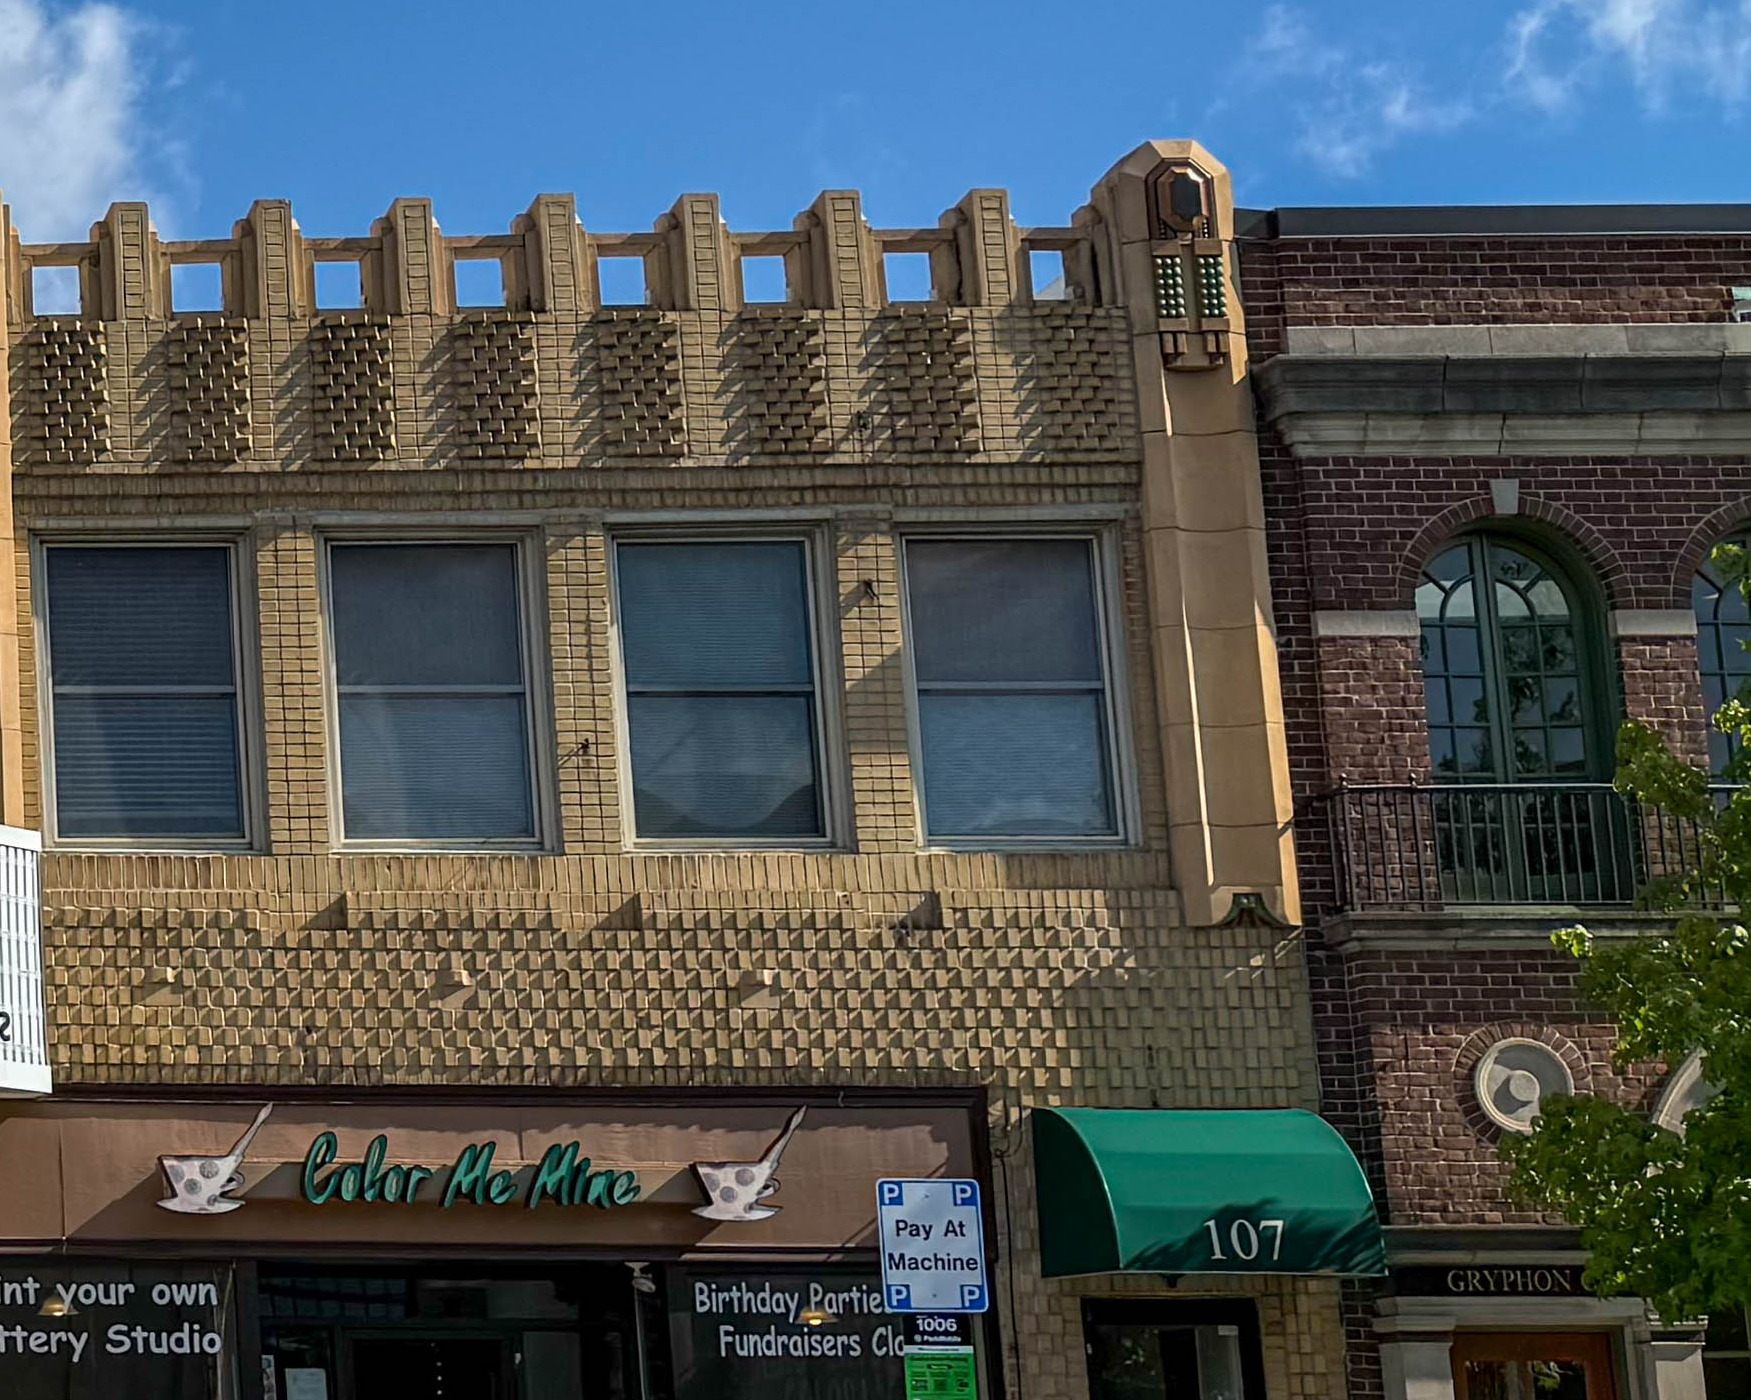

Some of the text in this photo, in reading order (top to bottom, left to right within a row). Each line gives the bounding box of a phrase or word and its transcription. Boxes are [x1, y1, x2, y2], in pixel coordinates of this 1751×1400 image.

[302, 1131, 641, 1209] Color Me Mine
[895, 1219, 966, 1241] Pay At
[1202, 1219, 1284, 1261] 107
[887, 1252, 979, 1272] Machine
[1447, 1269, 1571, 1292] GRYPHON
[55, 1282, 136, 1316] your
[151, 1282, 219, 1306] own
[694, 1281, 892, 1324] Birthday Partie
[104, 1322, 223, 1355] Studio
[718, 1324, 862, 1358] Fundraisers
[916, 1318, 958, 1332] 1006
